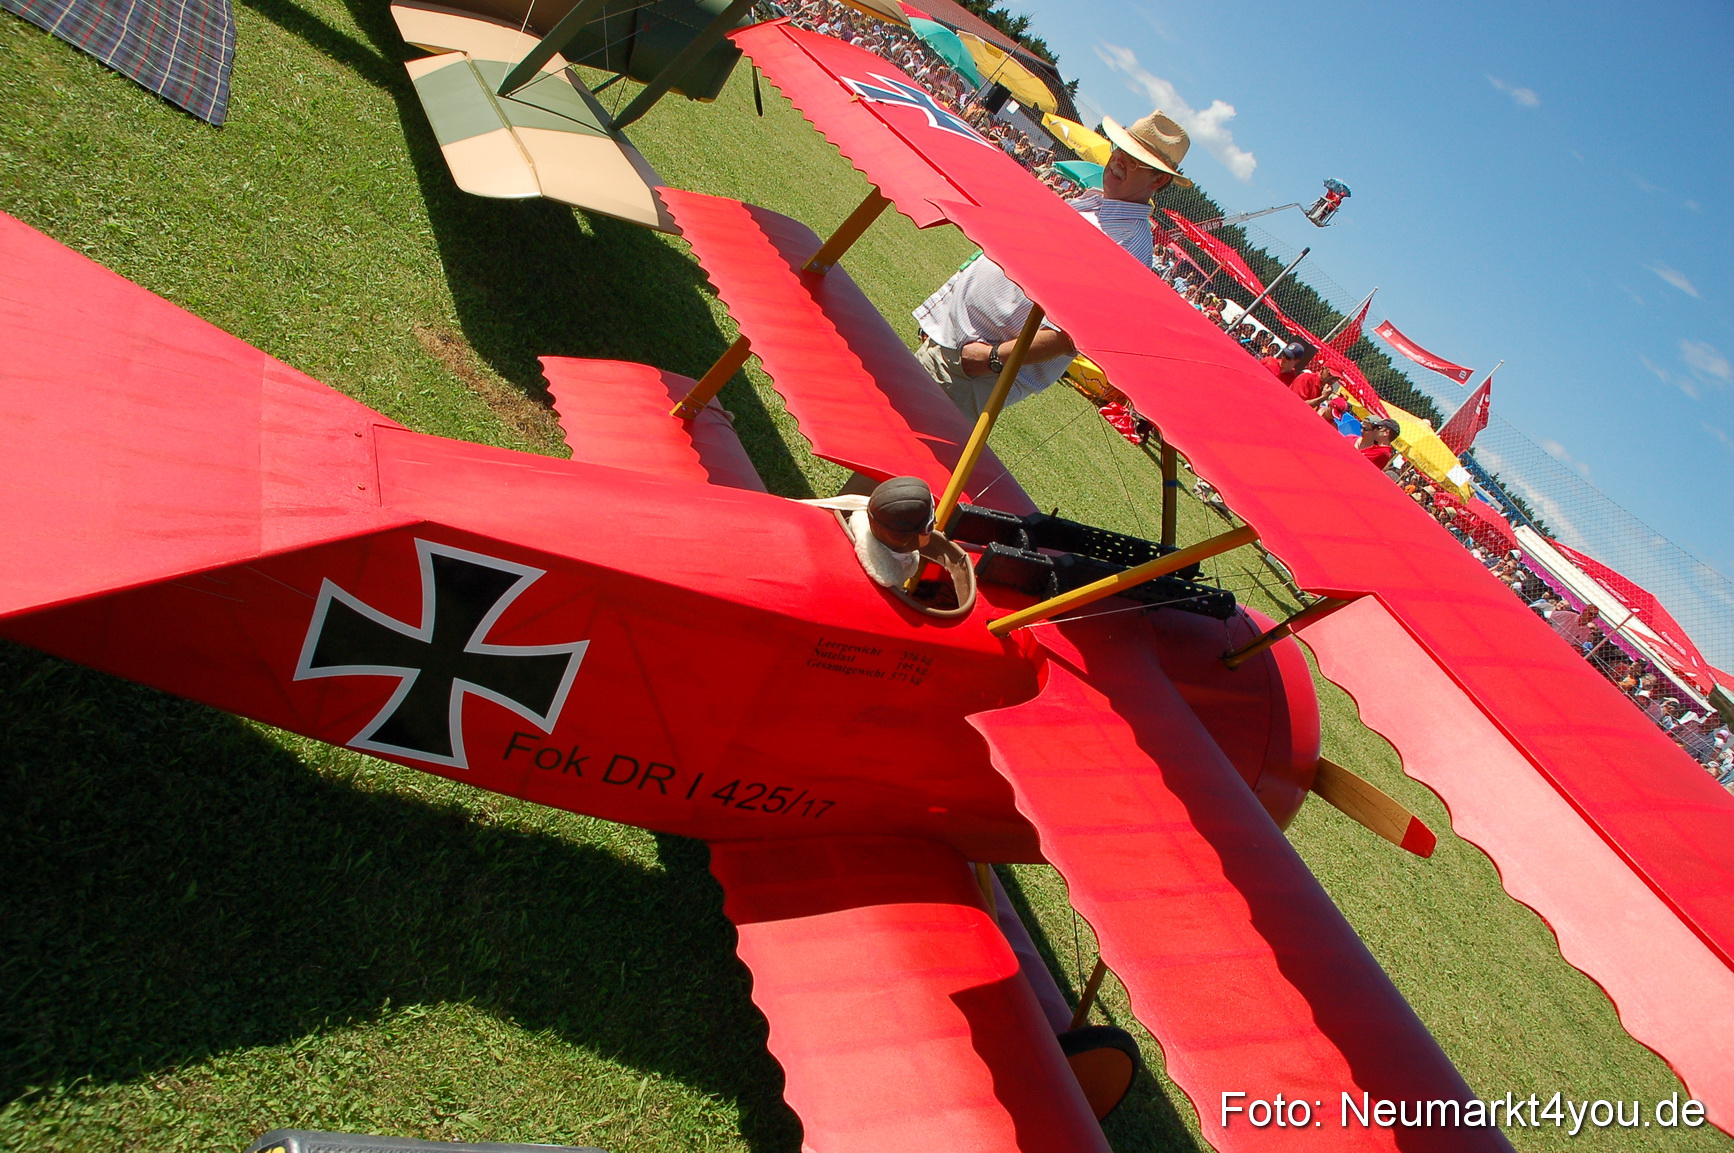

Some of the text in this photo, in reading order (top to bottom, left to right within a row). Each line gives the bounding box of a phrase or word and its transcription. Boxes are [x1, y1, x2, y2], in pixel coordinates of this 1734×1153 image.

[812, 647, 929, 676] Nutzlast 195 kg
[817, 637, 882, 657] Leergewicht
[921, 655, 934, 667] kg
[806, 658, 923, 687] Gesamtgewicht 571 kg
[502, 731, 591, 777] Fok
[602, 753, 677, 795] DR
[711, 779, 836, 819] 425/17
